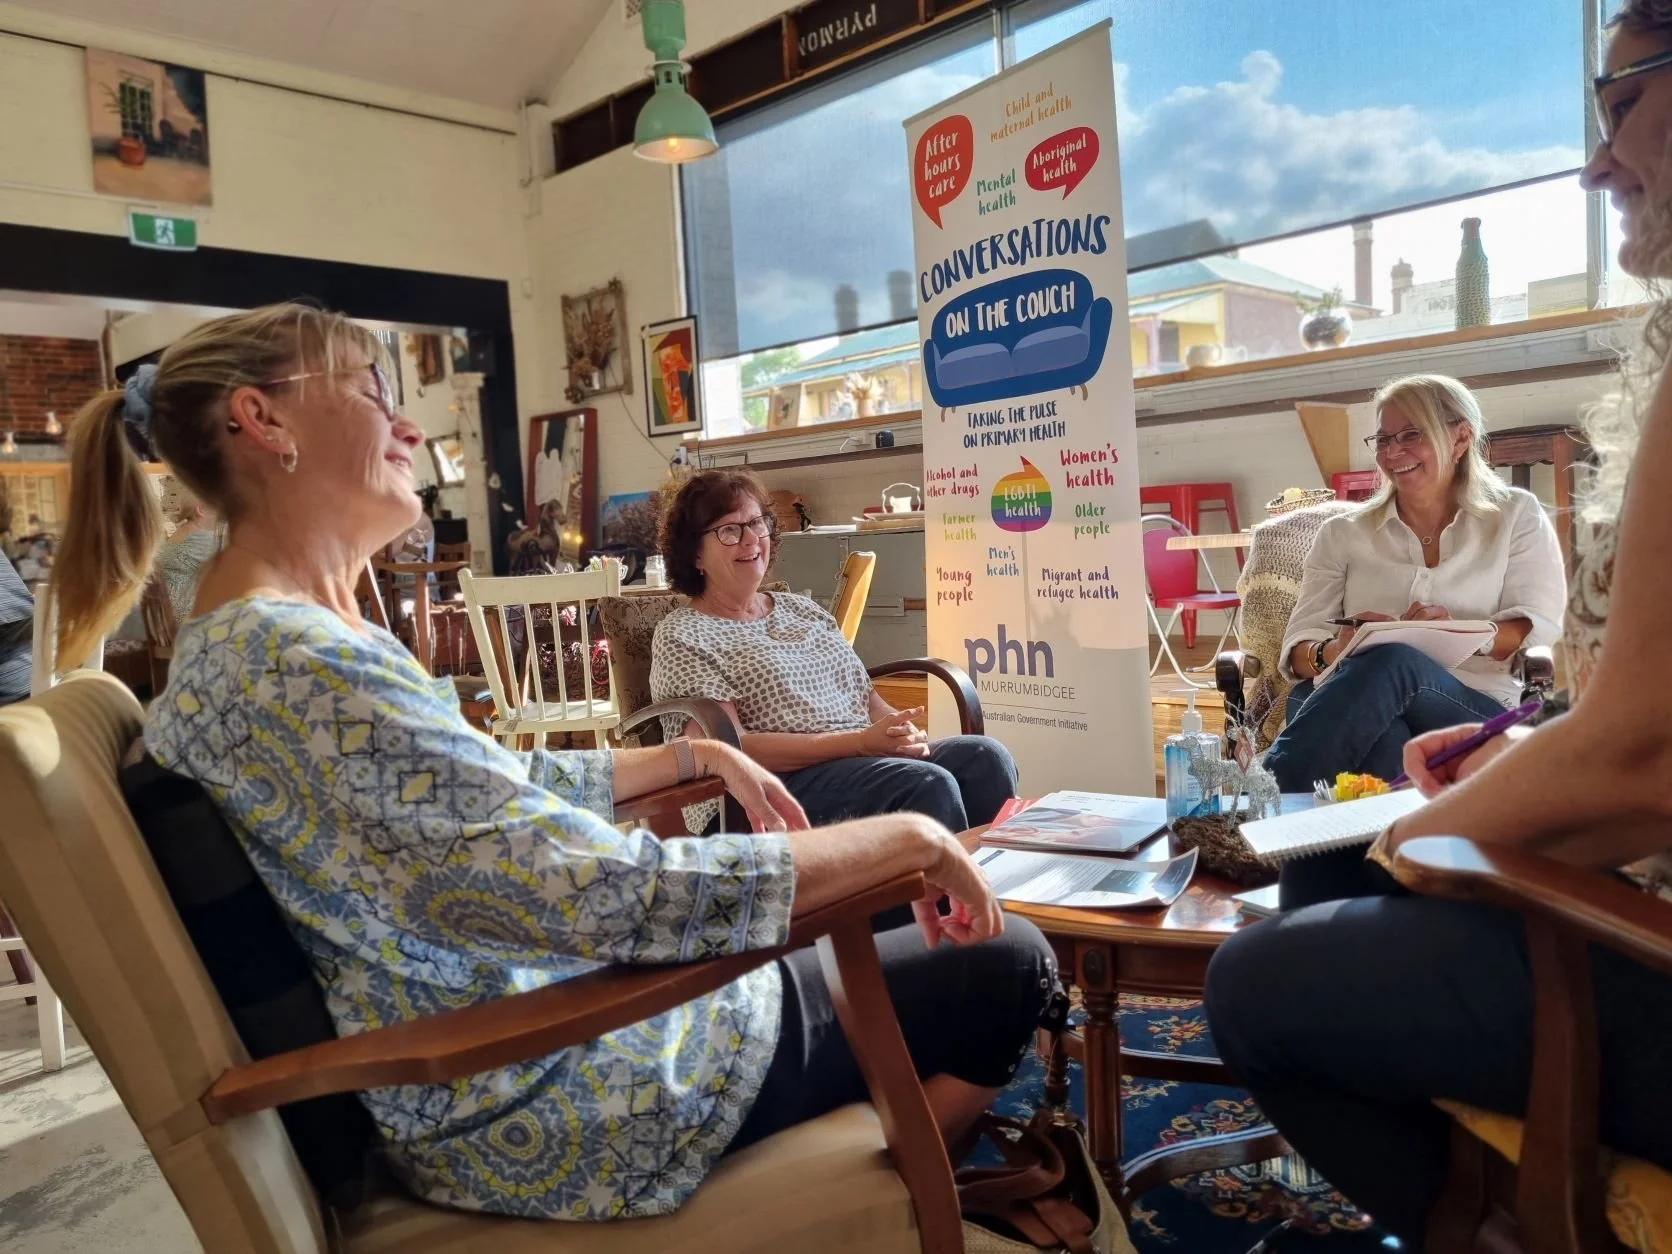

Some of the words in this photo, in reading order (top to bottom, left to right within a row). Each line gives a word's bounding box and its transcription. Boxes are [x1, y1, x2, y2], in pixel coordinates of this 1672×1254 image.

[1005, 92, 1031, 118] Child
[1035, 81, 1054, 104] and
[990, 111, 1034, 143] maternal
[1038, 95, 1072, 119] health
[925, 131, 958, 162] After
[1033, 133, 1087, 169] Aboriginal
[924, 153, 961, 181] hours
[1042, 159, 1077, 183] health
[929, 175, 956, 199] care
[976, 168, 1016, 196] Mental
[978, 190, 1016, 216] health
[920, 214, 1111, 303] CONVERSATIONS
[945, 307, 970, 338] ON
[974, 298, 1010, 331] THE
[1016, 281, 1076, 323] COUCH
[967, 408, 1005, 429] TAKING
[1007, 405, 1027, 423] THE
[1029, 400, 1058, 420] PULSE
[963, 432, 978, 449] ON
[980, 426, 1026, 448] PRIMARY
[1029, 421, 1066, 441] HEALTH
[1060, 443, 1119, 466] Women's
[926, 466, 956, 483] Alcohol
[959, 463, 978, 479] and
[1066, 467, 1114, 489] health
[926, 485, 946, 498] other
[951, 481, 980, 498] drugs
[1004, 484, 1036, 501] LGBTI
[1005, 500, 1041, 518] health
[1075, 502, 1106, 518] Older
[944, 528, 977, 541] health
[1074, 520, 1110, 540] people
[989, 545, 1016, 561] Men's
[936, 567, 972, 586] Young
[986, 563, 1020, 577] health
[1042, 567, 1082, 586] Migrant
[1087, 565, 1110, 581] and
[937, 587, 974, 606] people
[1037, 585, 1075, 603] refugee
[1079, 585, 1119, 600] health
[964, 623, 1055, 689] phn
[981, 680, 1076, 700] MURRUMBIDGEE
[982, 710, 1015, 723] Australian
[1017, 713, 1057, 728] Government
[1058, 718, 1088, 731] Initiative
